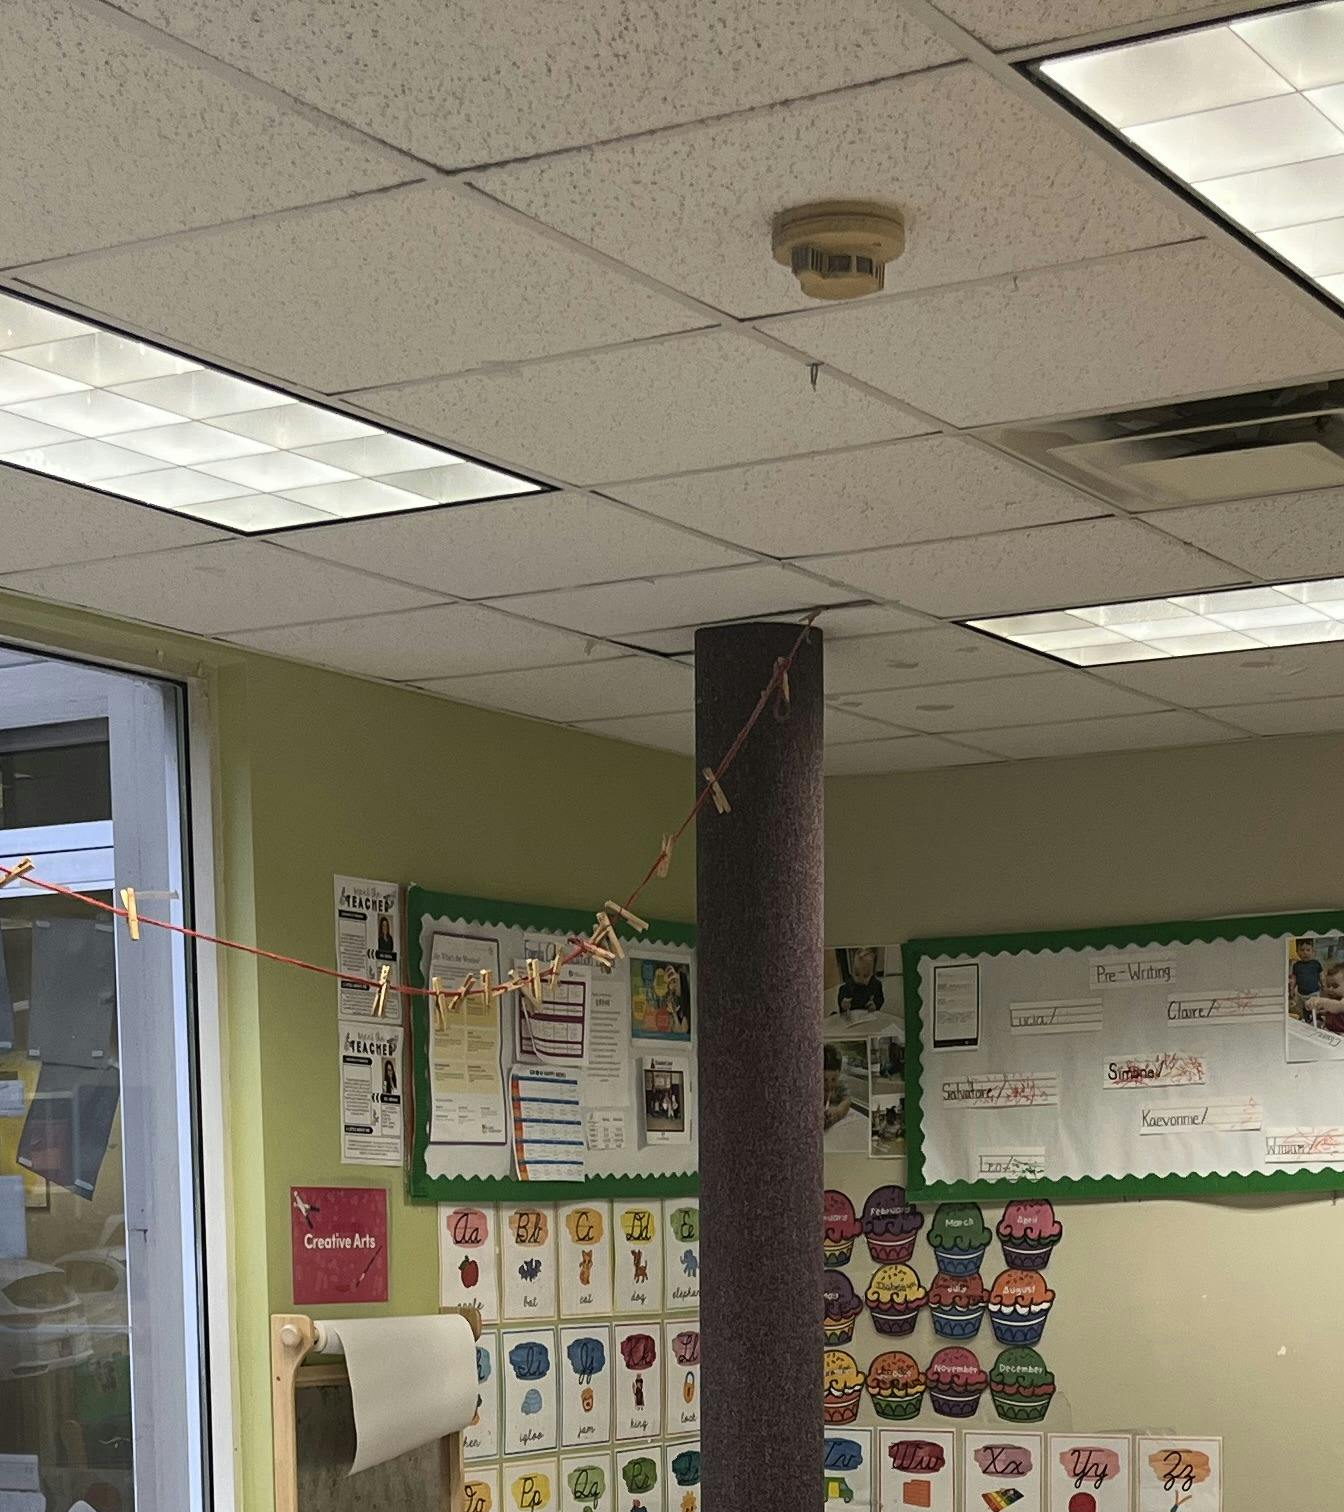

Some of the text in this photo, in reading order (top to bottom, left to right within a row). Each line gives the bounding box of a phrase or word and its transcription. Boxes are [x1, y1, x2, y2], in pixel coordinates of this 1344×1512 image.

[1096, 962, 1172, 984] Pre-Writing
[870, 1206, 911, 1217] February
[945, 1217, 974, 1228] March
[1016, 1215, 1039, 1227] April
[304, 1233, 376, 1250] Creative Arts
[672, 1286, 700, 1301] elephan
[1002, 1285, 1037, 1296] August
[523, 1296, 538, 1308] bat
[631, 1291, 647, 1306] dog
[934, 1364, 978, 1375] November
[999, 1363, 1043, 1374] December
[577, 1424, 596, 1438] jam
[630, 1417, 648, 1434] king
[519, 1428, 545, 1444] igloo
[981, 1446, 1026, 1475] Xx
[1070, 1448, 1109, 1490] Yy
[1161, 1449, 1197, 1493] Zz
